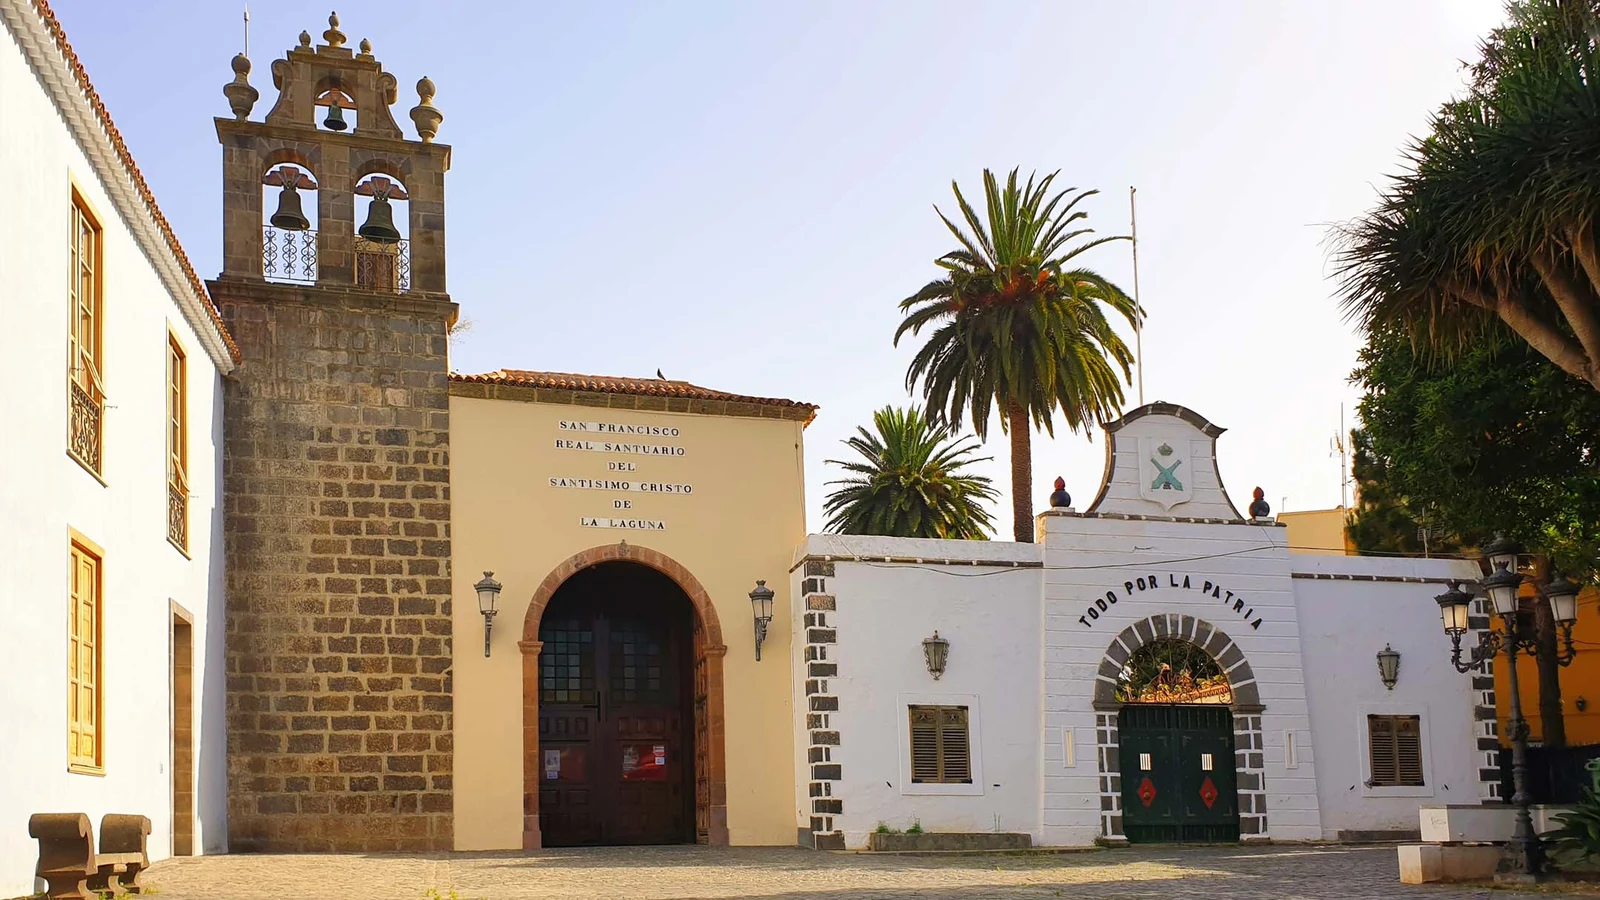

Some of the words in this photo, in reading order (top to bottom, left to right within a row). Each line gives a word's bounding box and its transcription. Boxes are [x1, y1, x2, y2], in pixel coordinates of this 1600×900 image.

[560, 421, 587, 430] SAN
[598, 423, 679, 437] FRANCISCO
[556, 440, 593, 450] REAL
[604, 443, 685, 456] SANTUARIO
[609, 462, 635, 471] DEL
[550, 478, 630, 490] SANTISIMO
[640, 483, 692, 494] CRISTO
[614, 500, 631, 509] DE
[581, 518, 598, 526] LA
[610, 519, 665, 530] LAGUNA
[1078, 591, 1118, 628] TODO
[1124, 575, 1158, 595] POR
[1169, 574, 1191, 589] LA
[1203, 580, 1263, 630] PATRIA
